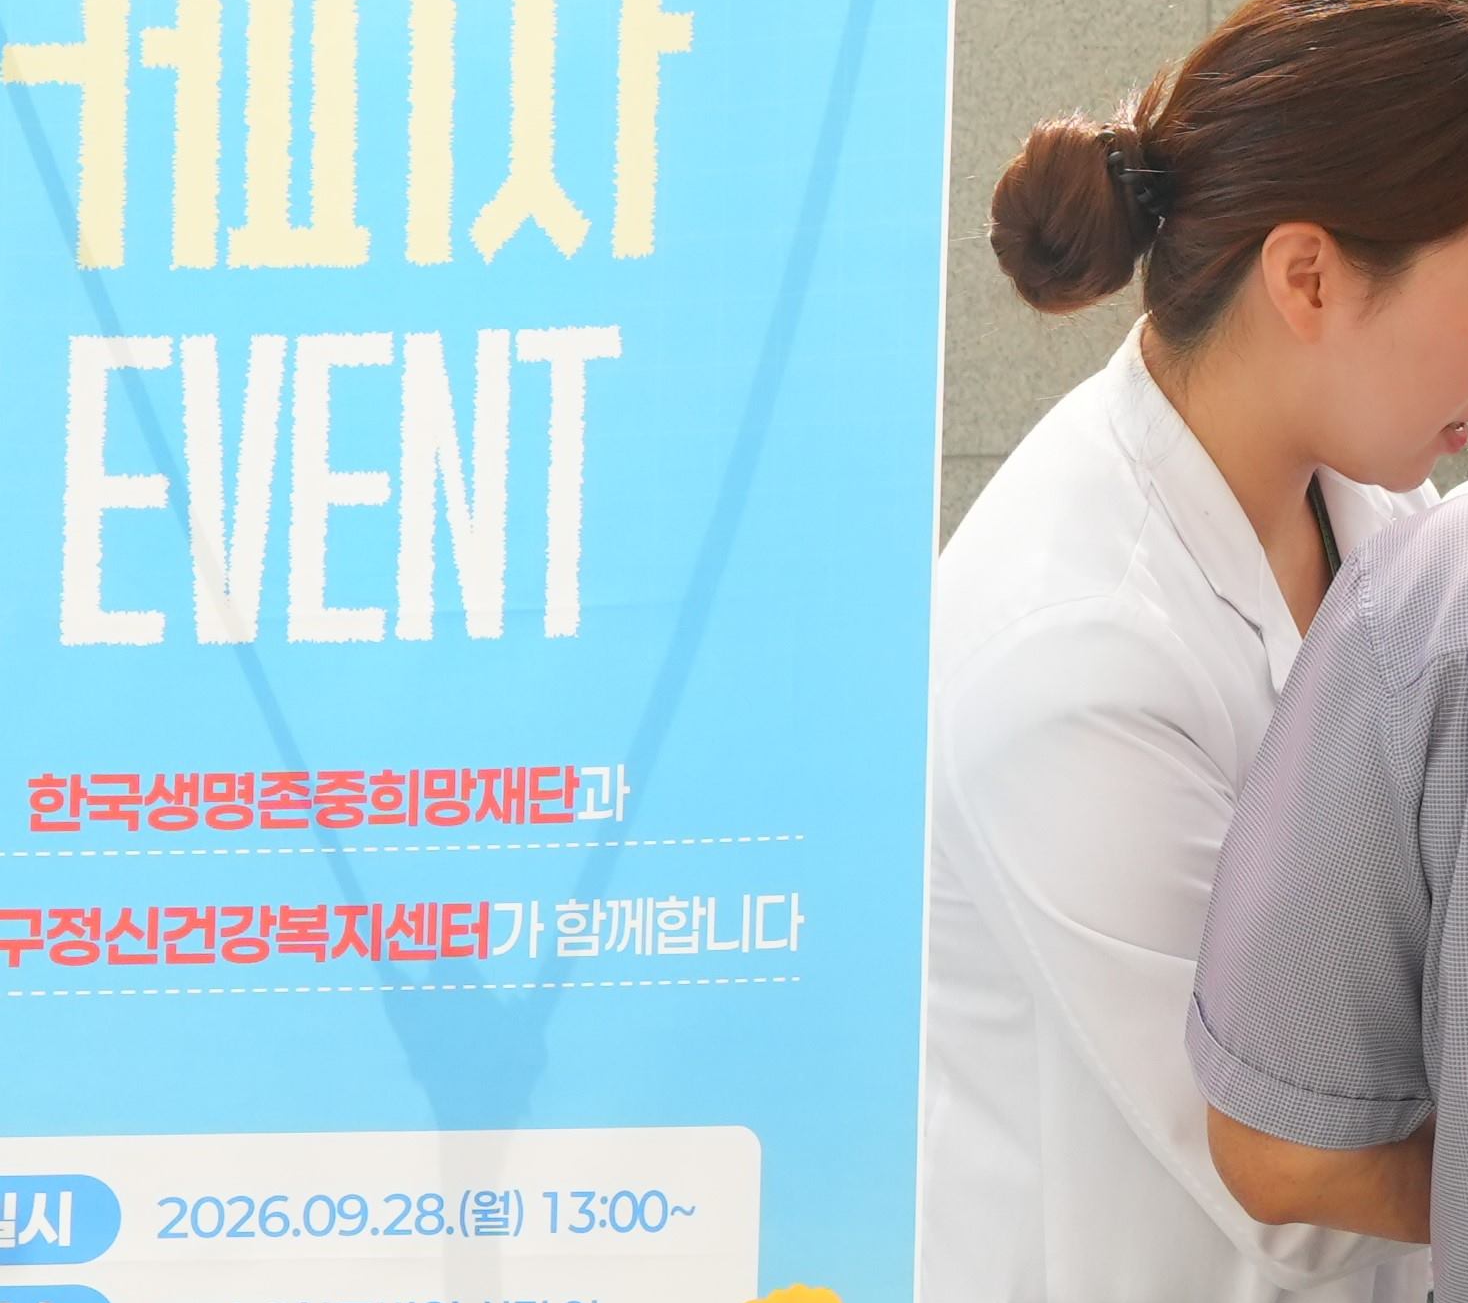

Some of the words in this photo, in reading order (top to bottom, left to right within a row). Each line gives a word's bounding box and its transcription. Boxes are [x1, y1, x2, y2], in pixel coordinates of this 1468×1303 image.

[59, 326, 624, 647] EVENT
[26, 764, 632, 833] 한국생명존중희망재단과
[0, 897, 545, 969] 구정신건강복지센터가
[553, 890, 806, 958] 함께합니다
[155, 1189, 527, 1242] 2026.09.28.(월)
[541, 1188, 698, 1236] 13:00~
